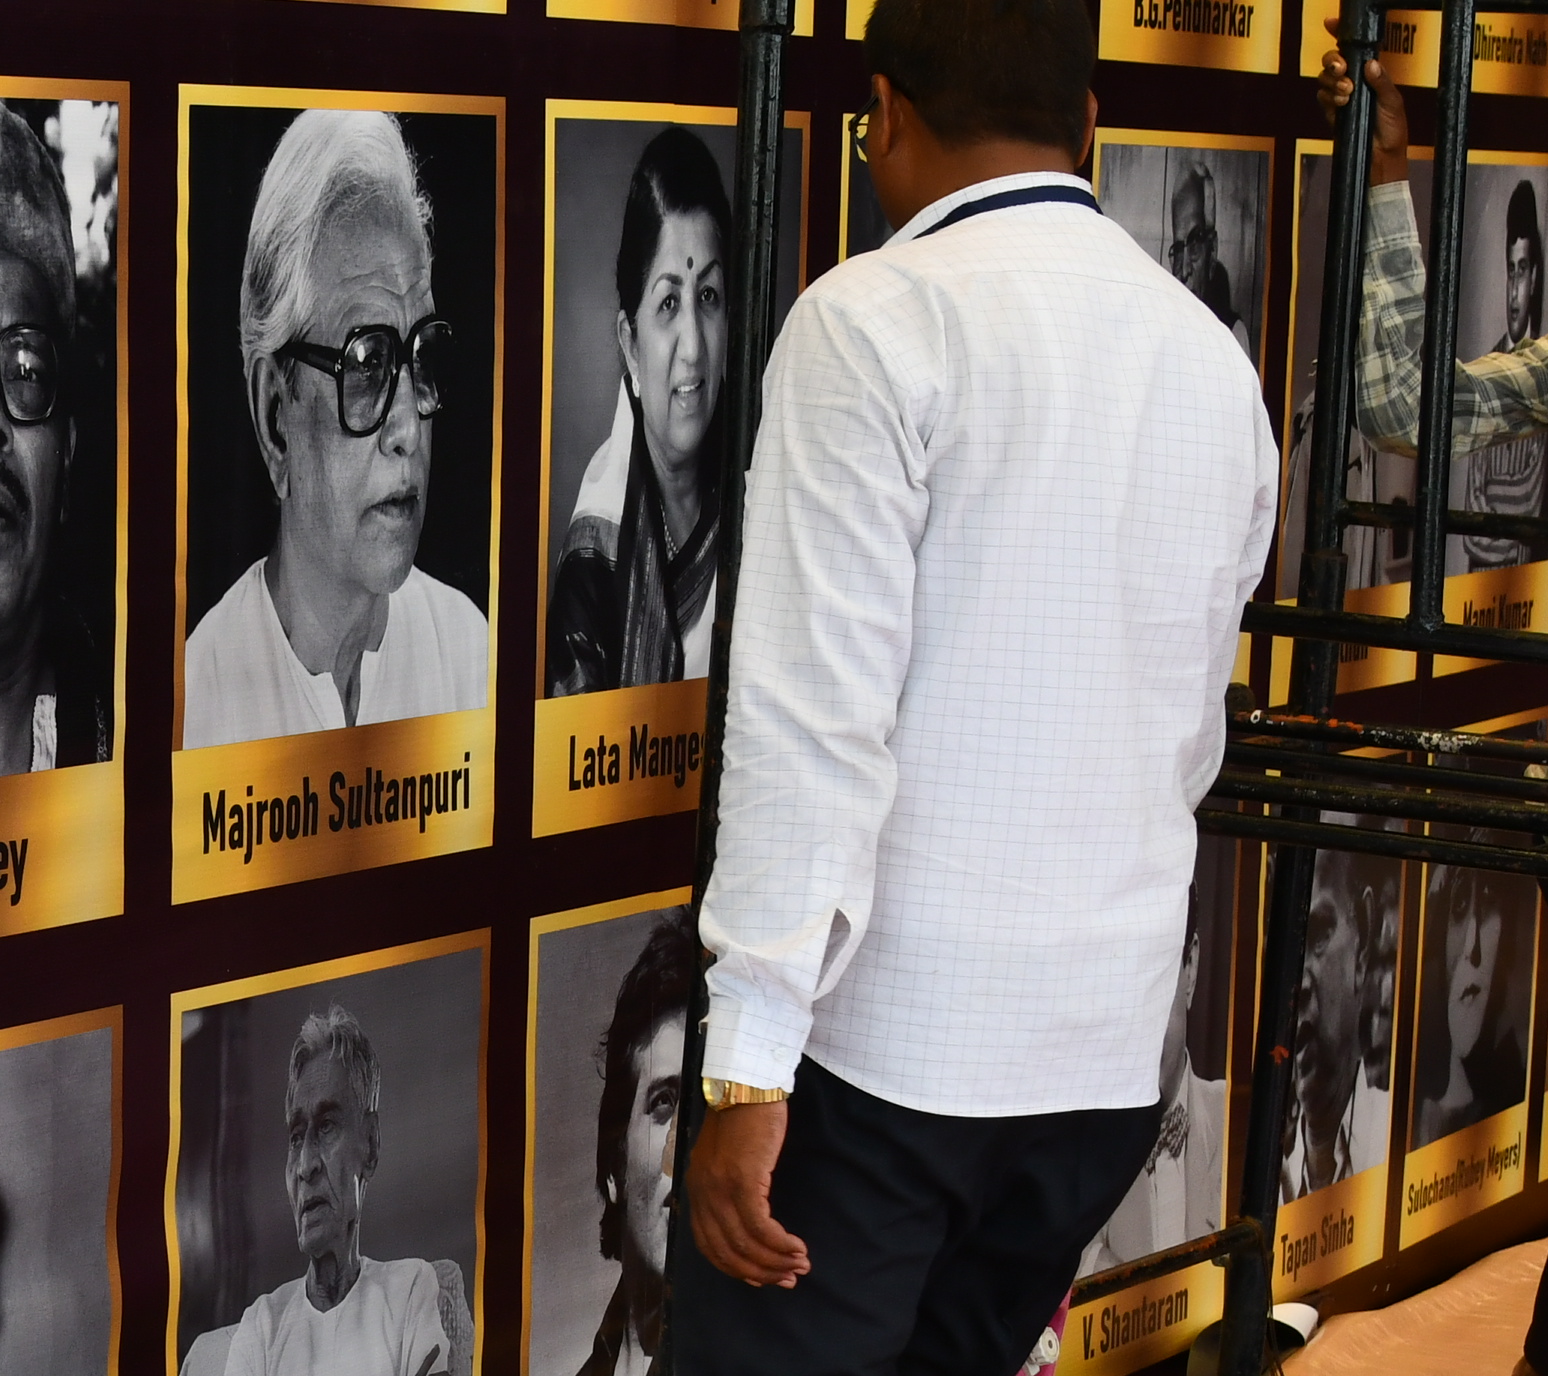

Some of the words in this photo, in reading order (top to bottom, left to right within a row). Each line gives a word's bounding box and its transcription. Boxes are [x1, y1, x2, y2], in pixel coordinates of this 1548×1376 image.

[569, 735, 620, 791] Lata
[203, 776, 320, 864] Majrooh
[328, 752, 471, 833] Sultanpuri
[1280, 1230, 1316, 1283] Tapan
[1320, 1207, 1354, 1255] Sinha
[1082, 1313, 1096, 1361] V.
[1100, 1287, 1189, 1354] Shantaram
